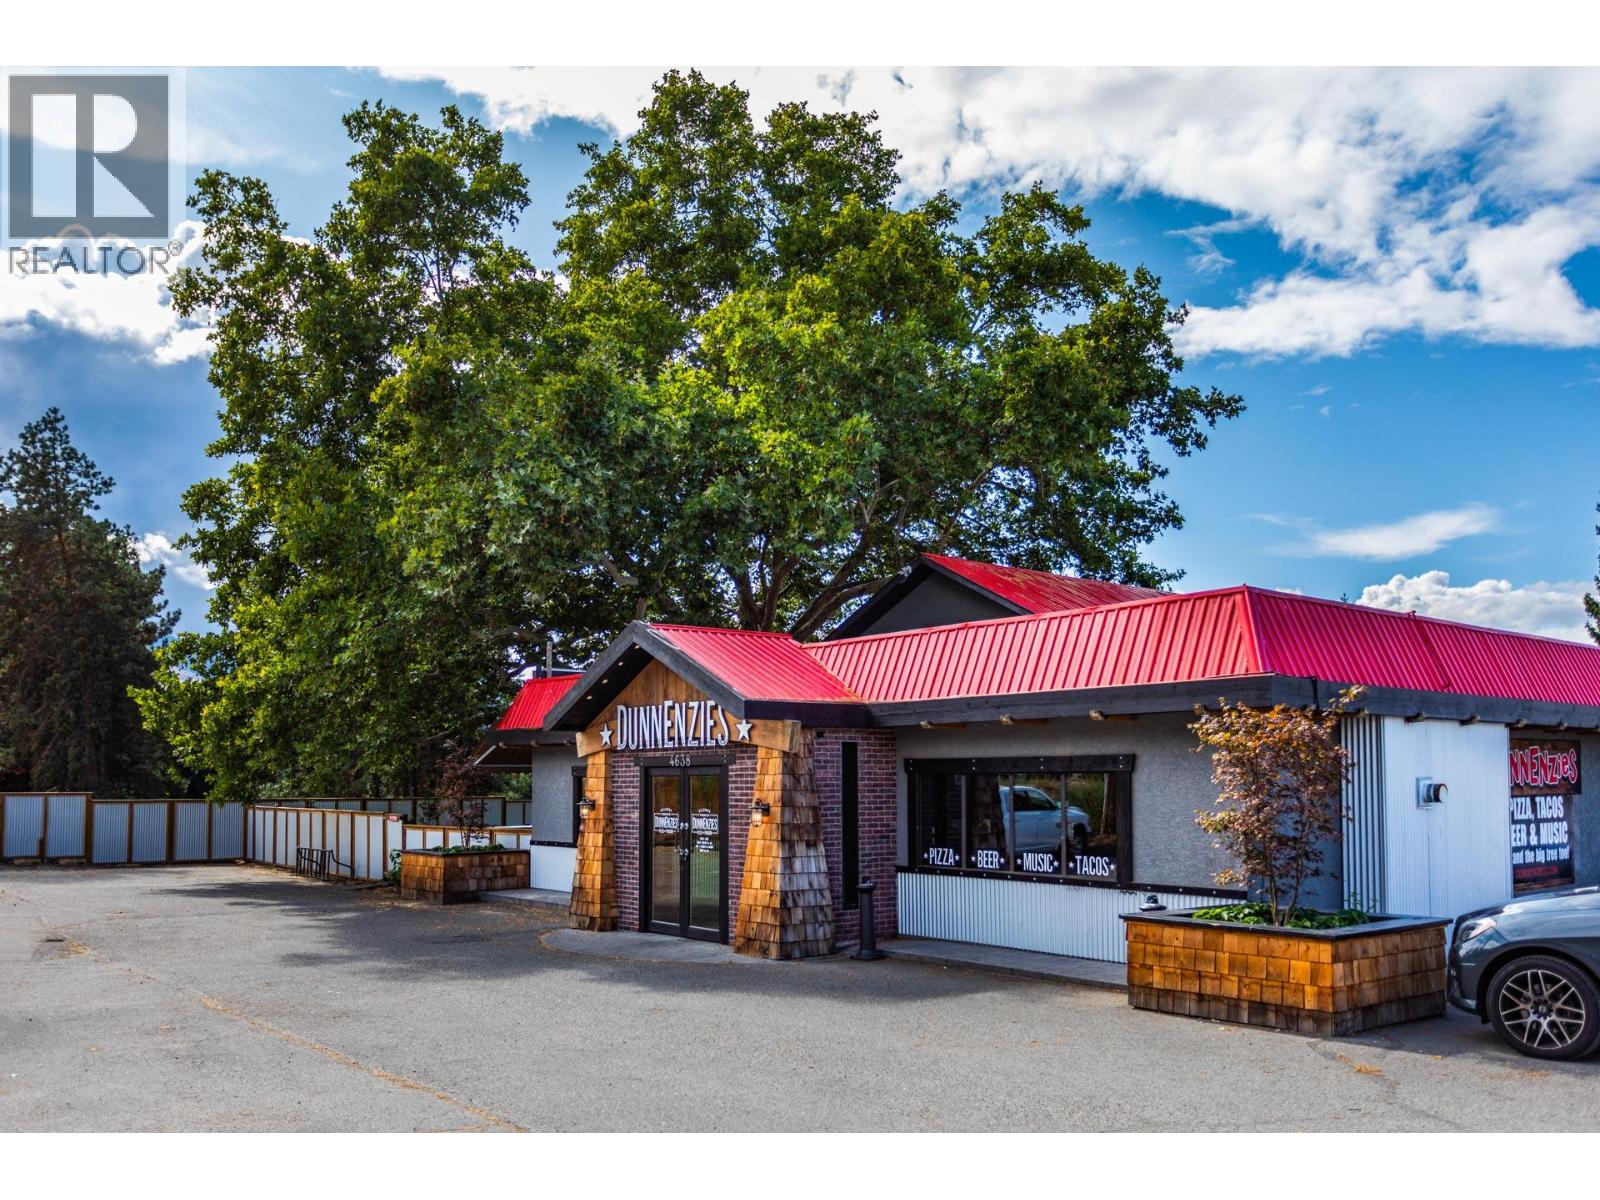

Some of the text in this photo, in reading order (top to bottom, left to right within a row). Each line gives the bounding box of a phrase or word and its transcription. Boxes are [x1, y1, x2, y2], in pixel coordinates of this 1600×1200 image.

[617, 700, 729, 750] DUNNENZIES
[669, 754, 691, 767] 4638
[1535, 795, 1564, 819] TACOS
[1511, 820, 1569, 847] EER & MUSIC
[929, 847, 955, 866] PIZZA
[977, 850, 1000, 869] BEER
[1023, 852, 1054, 873] MUSIC
[1075, 855, 1110, 876] TACOS
[1512, 850, 1524, 865] and
[1525, 849, 1535, 863] the
[1535, 848, 1545, 864] big
